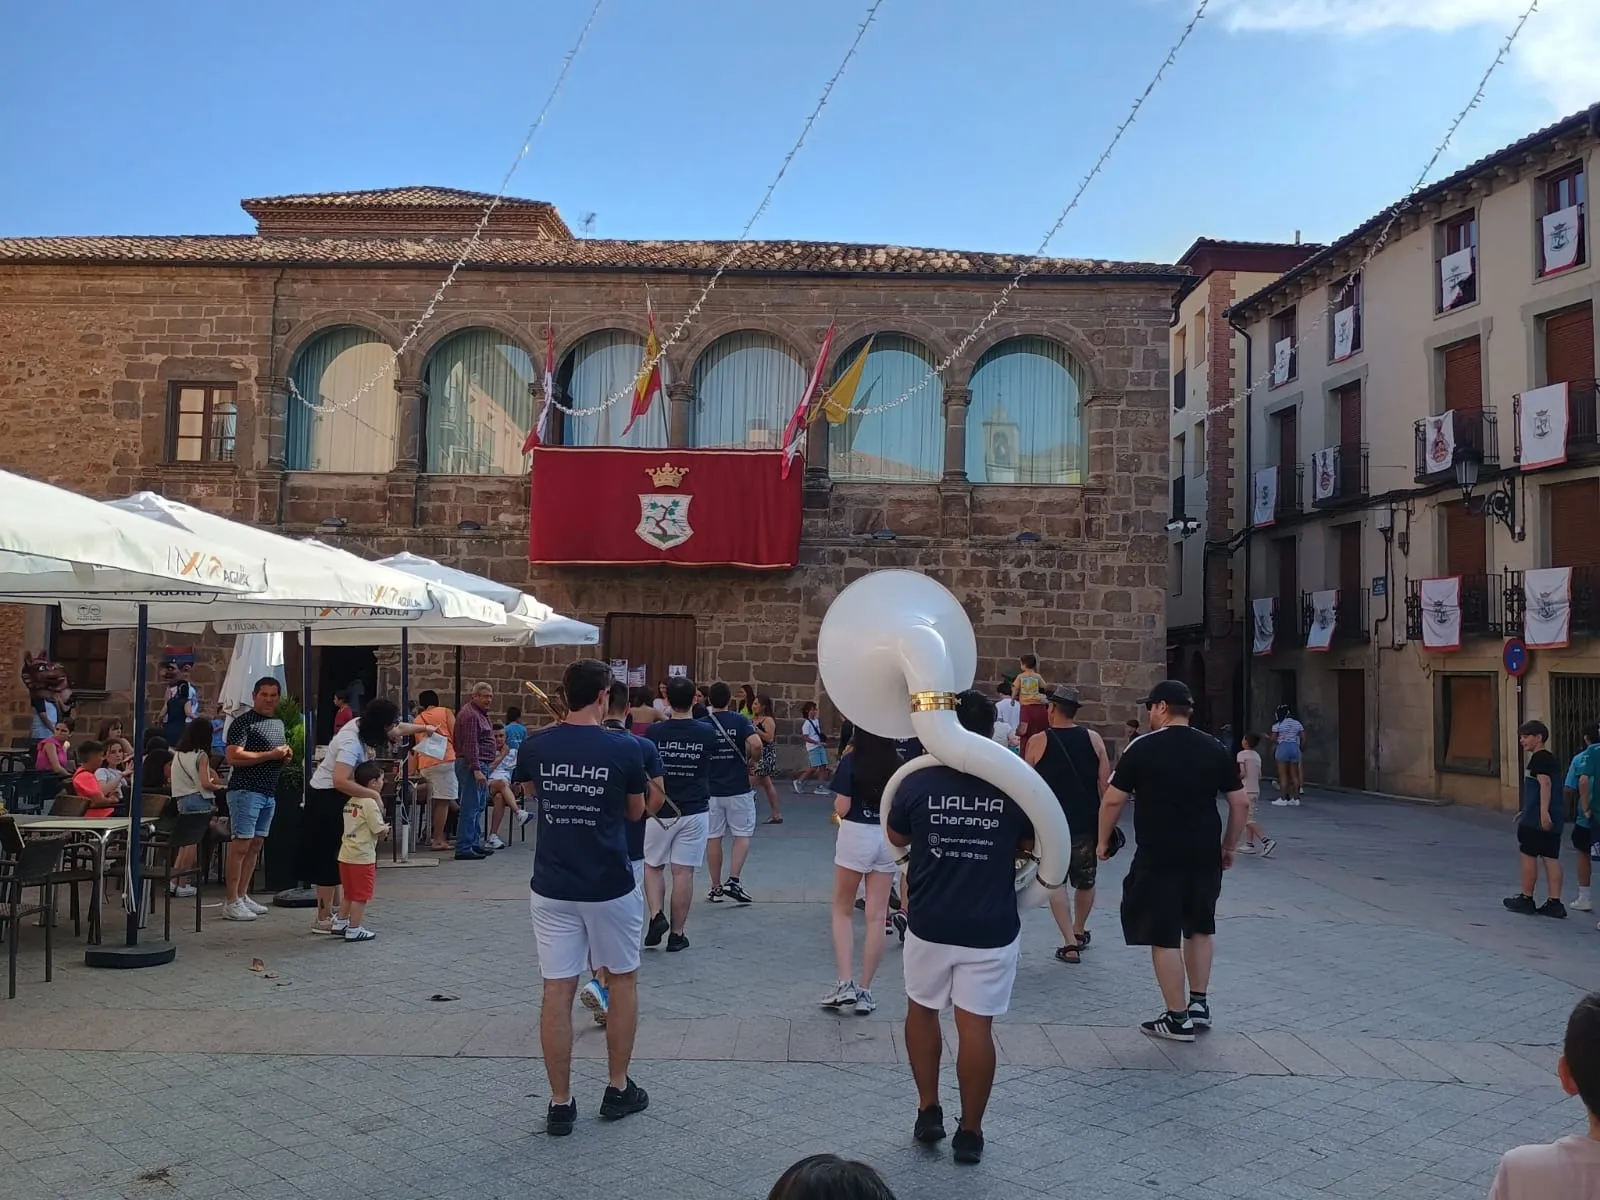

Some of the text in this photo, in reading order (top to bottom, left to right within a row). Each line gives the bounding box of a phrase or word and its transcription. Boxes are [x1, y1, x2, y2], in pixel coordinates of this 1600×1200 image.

[658, 741, 704, 751] LIALHA
[659, 751, 701, 760] Charanga
[540, 763, 609, 781] LIALHA
[542, 780, 604, 797] Charanga
[928, 795, 1004, 813] LIALHA
[930, 813, 999, 830] Charanga
